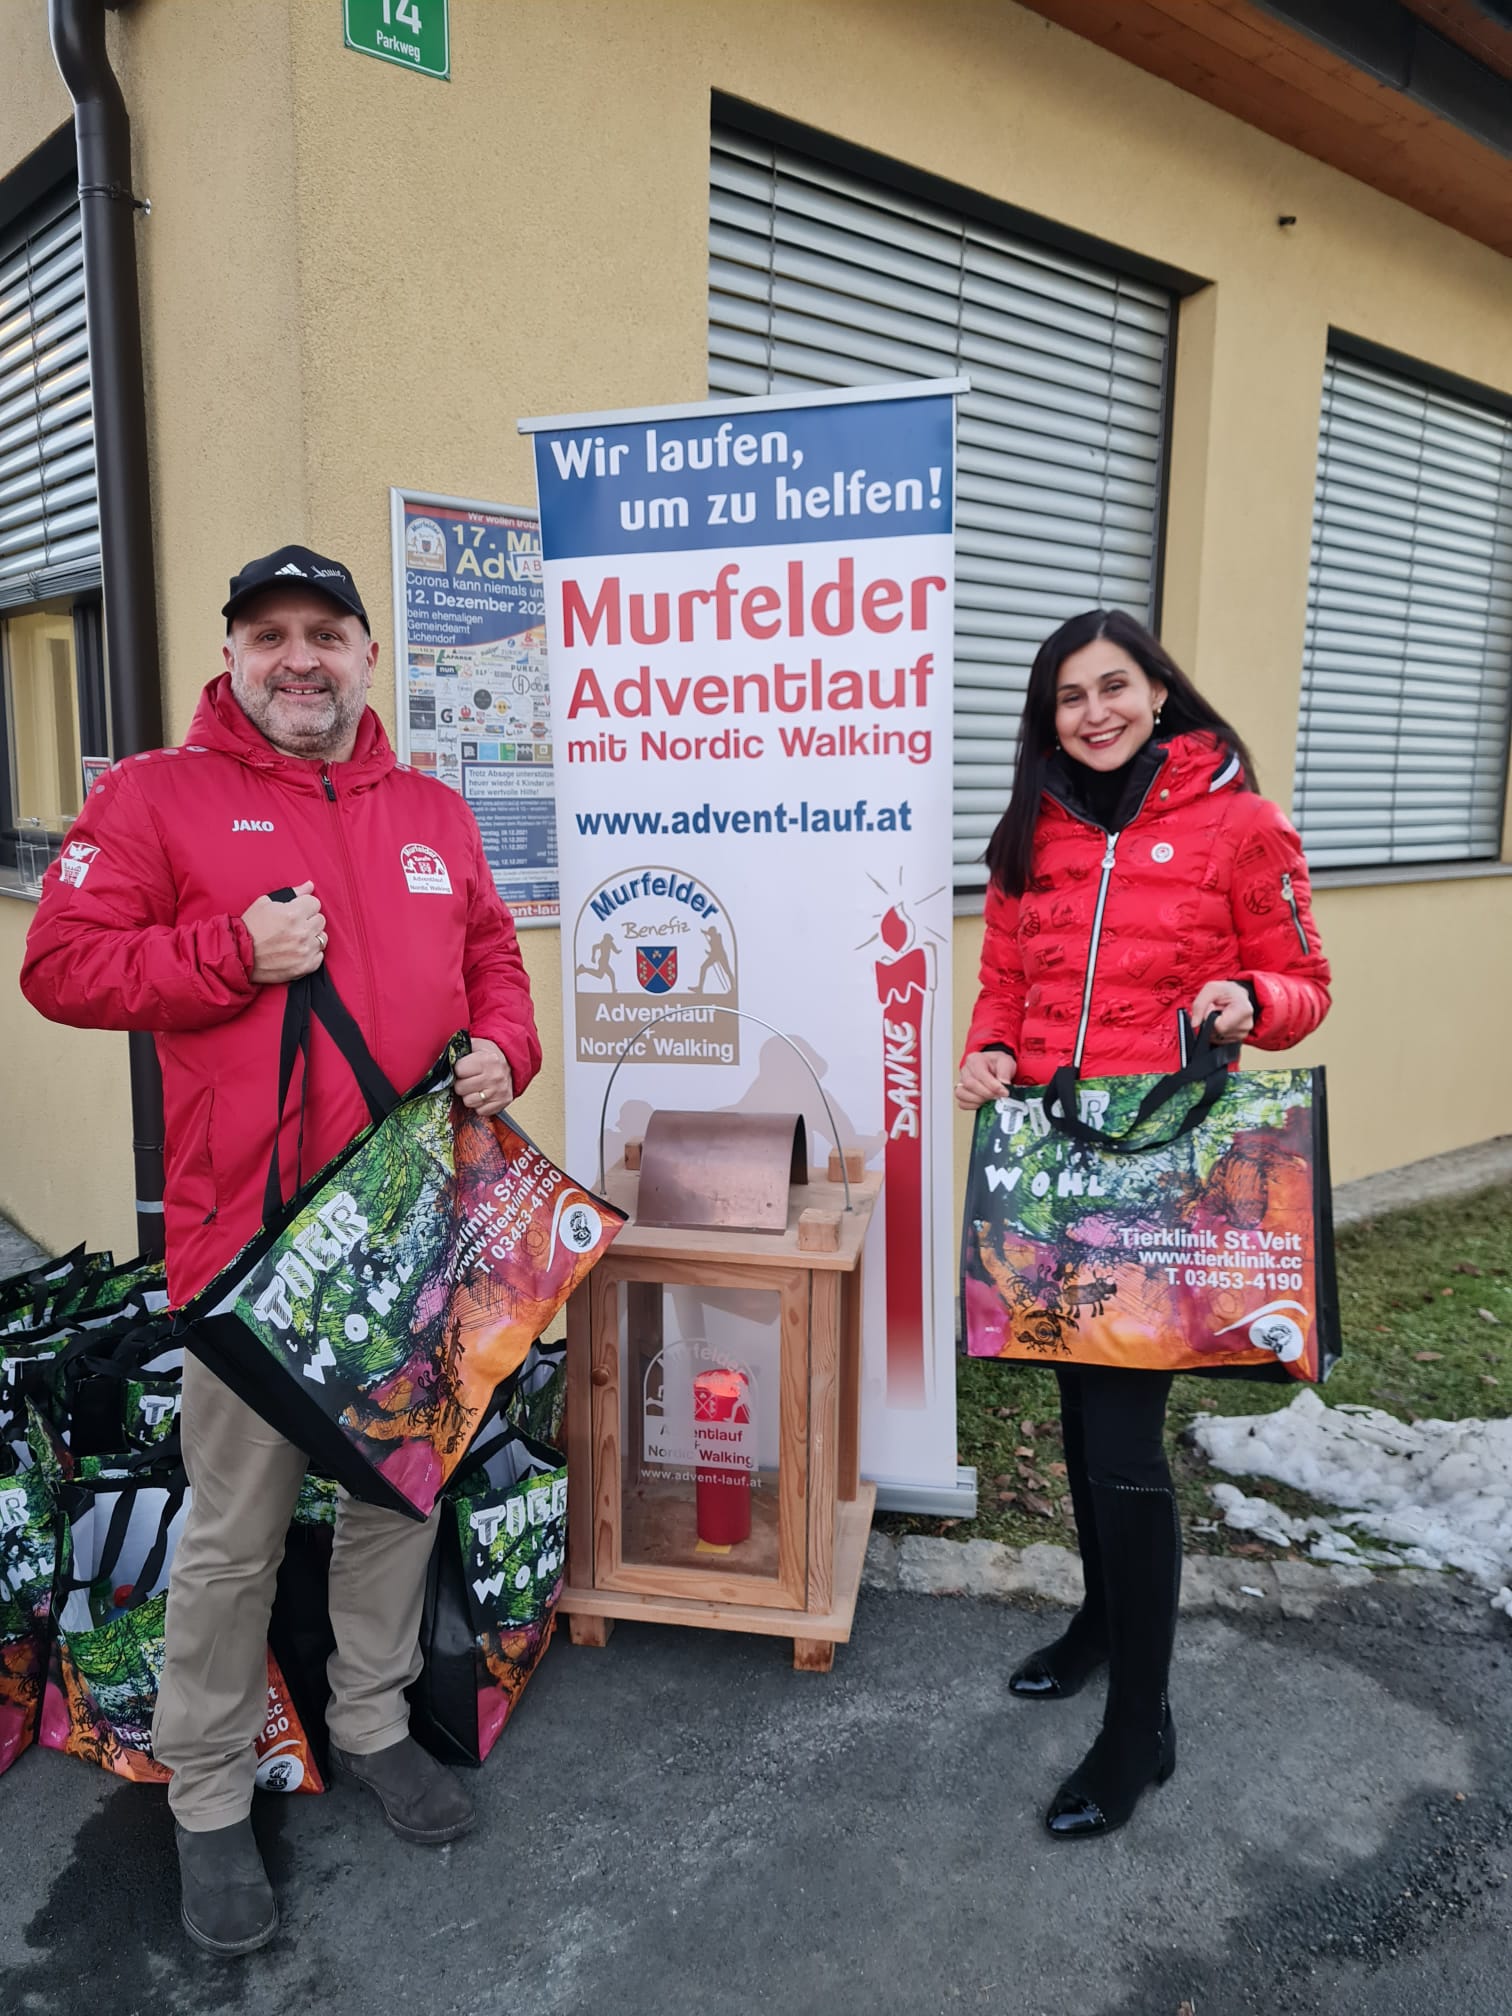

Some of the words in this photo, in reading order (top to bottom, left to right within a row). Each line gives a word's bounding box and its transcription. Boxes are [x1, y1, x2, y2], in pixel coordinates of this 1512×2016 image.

[381, 0, 422, 35] 14
[376, 30, 421, 62] Parkweg
[551, 437, 629, 480] Wir
[646, 423, 805, 473] laufen,
[619, 496, 690, 531] um
[706, 490, 757, 526] zu
[775, 466, 944, 522] helfen!
[452, 524, 496, 549] 17.
[406, 571, 450, 588] Corona
[453, 577, 481, 592] kann
[484, 581, 527, 598] niemals
[406, 590, 429, 605] 12.
[434, 592, 514, 613] Dezember
[561, 557, 948, 648] Murfelder
[407, 609, 430, 620] beim
[431, 610, 484, 624] ehemaligen
[407, 620, 470, 634] Gemeindeamt
[408, 631, 456, 644] Lichendorf
[567, 652, 934, 720] Adventlauf
[567, 732, 627, 764] mit
[641, 728, 765, 762] Nordic
[778, 723, 933, 765] Walking
[469, 769, 486, 777] Trotz
[488, 769, 514, 778] Absage
[232, 819, 275, 832] JAKO
[575, 799, 912, 836] www.advent-lauf.at
[589, 872, 719, 922] Murfelder
[621, 916, 691, 940] Benefiz
[595, 1002, 717, 1023] Adventlauf
[580, 1037, 646, 1056] Nordic
[653, 1038, 734, 1063] Walking
[884, 1018, 920, 1140] DANKE
[494, 1178, 516, 1203] St.
[984, 1164, 1106, 1198] WOHL
[455, 1158, 550, 1282] www.tierklinik.cc
[474, 1257, 495, 1275] T.
[491, 1170, 562, 1259] 03453-4190
[1119, 1227, 1218, 1249] Tierklinik
[252, 1191, 368, 1329] TIER
[1138, 1251, 1302, 1270] www.tierklinik.cc
[1165, 1268, 1180, 1286] T.
[1185, 1270, 1302, 1291] 03453-4190
[303, 1262, 414, 1384] WOHL
[699, 1450, 754, 1468] Walking
[641, 1469, 762, 1488] www.advent-lauf.at
